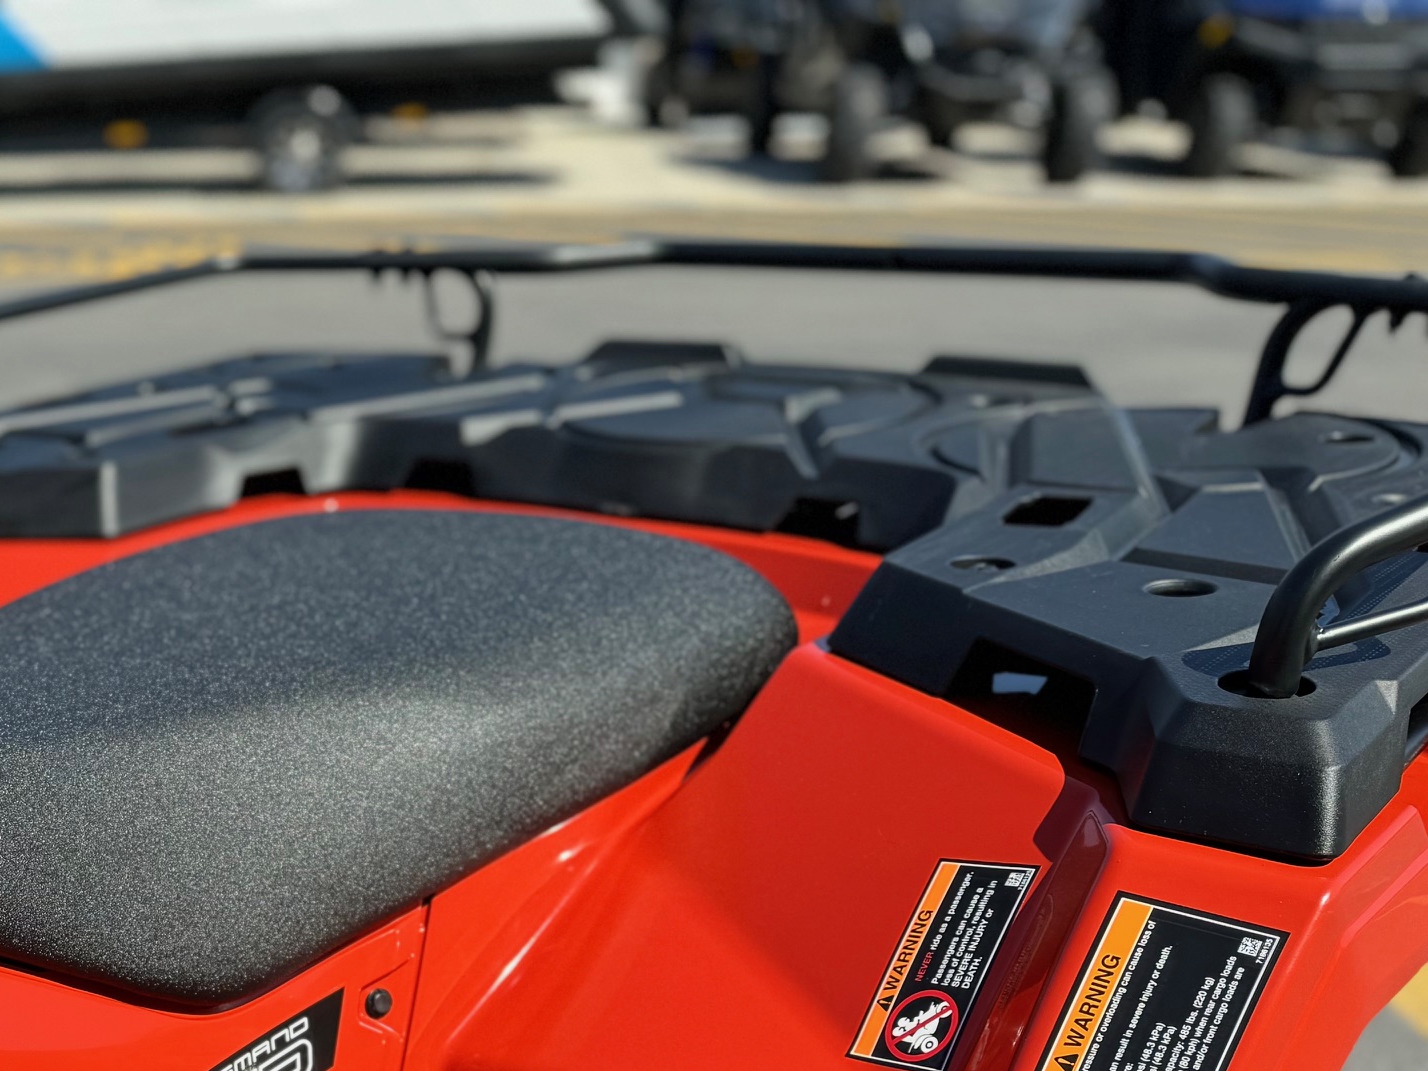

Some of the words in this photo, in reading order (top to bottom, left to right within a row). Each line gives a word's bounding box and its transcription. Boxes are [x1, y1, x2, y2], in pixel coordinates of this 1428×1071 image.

[987, 880, 998, 888] in
[971, 889, 994, 924] resulting
[915, 952, 934, 982] NEVER
[930, 934, 943, 950] ride
[938, 923, 948, 933] as
[947, 872, 974, 915] passenger.
[931, 937, 959, 984] Passengers
[955, 920, 968, 936] can
[963, 894, 980, 919] cause
[951, 953, 973, 987] SEVERE
[967, 919, 988, 951] INJURY
[985, 908, 994, 918] or
[956, 926, 976, 957] control,
[884, 910, 933, 990] WARNING
[1155, 945, 1173, 970] death.
[951, 958, 963, 968] of
[961, 957, 983, 989] DEATH.
[1220, 956, 1237, 977] loads
[940, 969, 959, 986] loss
[1095, 1032, 1104, 1042] or
[1100, 987, 1127, 1032] overloading
[1121, 971, 1133, 986] can
[1128, 947, 1144, 971] cause
[1137, 930, 1152, 947] loss
[1147, 920, 1156, 930] of
[1151, 970, 1161, 979] or
[1201, 977, 1215, 990] kg)
[1139, 979, 1157, 1002] injury
[1193, 990, 1207, 1008] (220
[1211, 977, 1227, 1000] cargo
[1064, 955, 1121, 1046] WARNING
[1204, 999, 1216, 1016] rear
[1129, 1002, 1146, 1029] severe
[1185, 1010, 1199, 1024] lbs.
[1192, 1044, 1209, 1070] and/or
[1203, 1025, 1218, 1044] front
[1213, 1002, 1228, 1025] cargo
[1222, 980, 1239, 1002] loads
[1234, 967, 1245, 980] are
[1122, 1029, 1134, 1038] in
[1149, 1022, 1166, 1041] kPa)
[1160, 1026, 1178, 1045] kPa)
[1179, 1024, 1192, 1040] 485
[1194, 1016, 1209, 1037] when
[1114, 1038, 1130, 1061] result
[1184, 1038, 1200, 1056] kph)
[1178, 1056, 1191, 1069] (80
